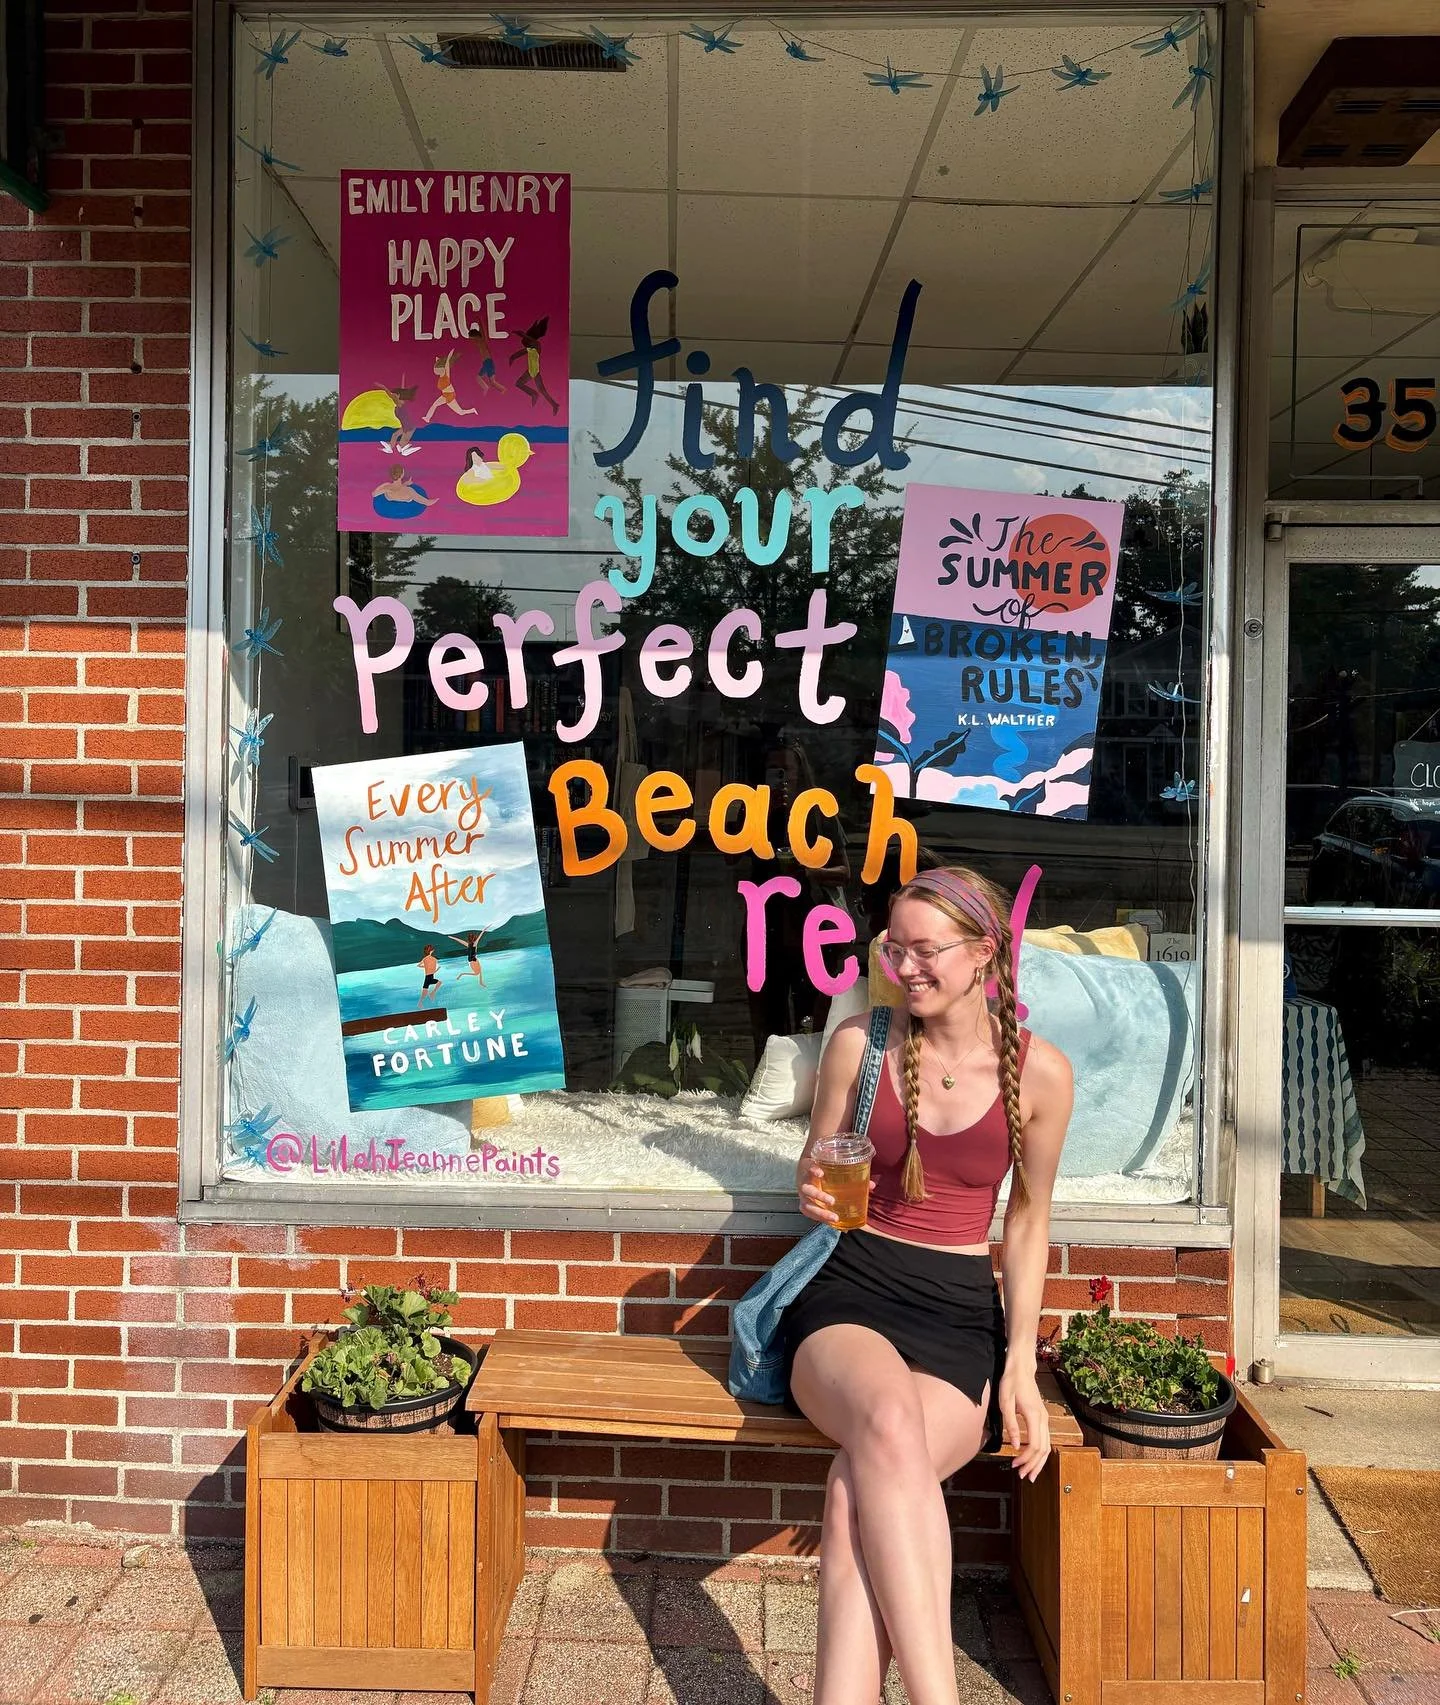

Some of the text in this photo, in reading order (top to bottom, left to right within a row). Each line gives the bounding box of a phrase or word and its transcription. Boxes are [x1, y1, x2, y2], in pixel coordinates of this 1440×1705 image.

[348, 174, 564, 215] EMILY HENRY
[387, 236, 515, 288] HAPPY
[390, 292, 510, 342] PLACE
[593, 269, 923, 470] find
[1334, 377, 1437, 450] 35
[594, 484, 865, 598] your
[987, 515, 1074, 556] The
[937, 552, 1107, 596] SUMMER
[924, 622, 1092, 666] BROKEN
[960, 664, 1085, 709] RULES
[958, 713, 1055, 727] K.L. WALTHER
[368, 775, 493, 831] Every
[547, 759, 918, 885] Beach
[339, 825, 485, 876] Summer
[404, 863, 496, 923] After
[1166, 937, 1181, 945] The
[382, 1008, 507, 1045] CARLEY
[373, 1032, 529, 1077] FORTUNE
